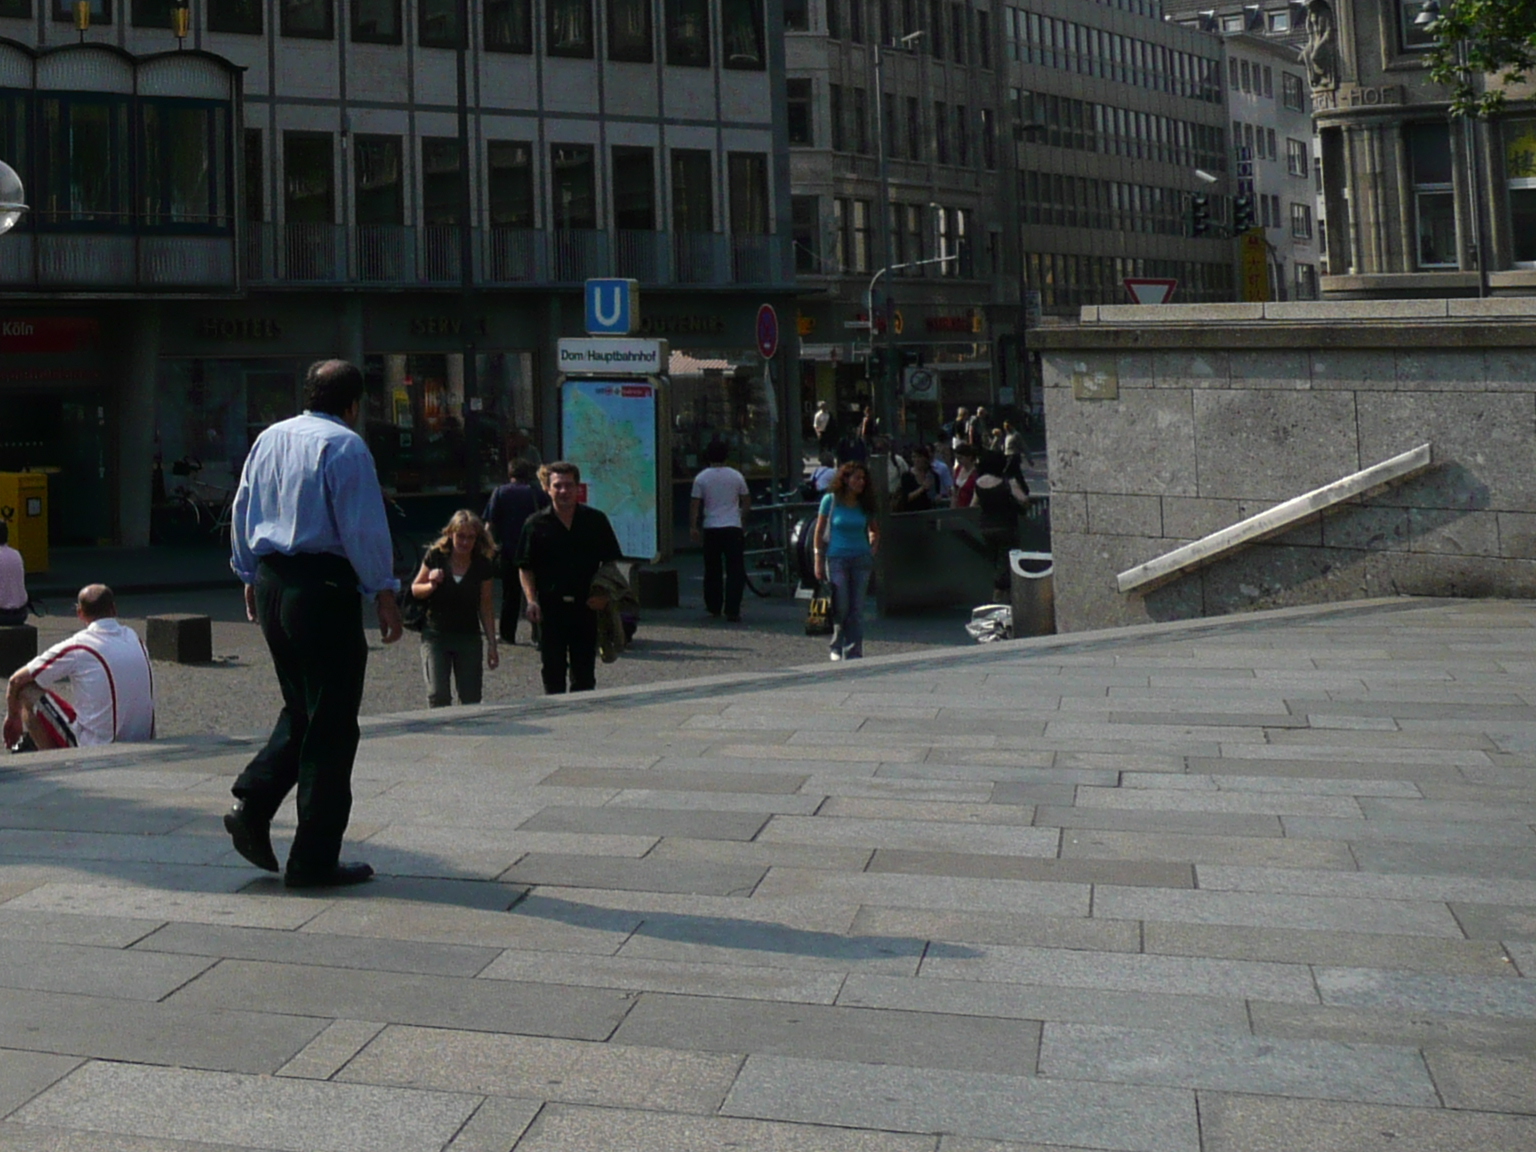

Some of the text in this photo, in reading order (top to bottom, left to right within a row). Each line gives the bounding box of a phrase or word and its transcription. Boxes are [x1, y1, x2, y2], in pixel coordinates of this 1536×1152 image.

[594, 286, 622, 327] U
[2, 321, 34, 336] Köln
[640, 315, 725, 335] OUVENIRS
